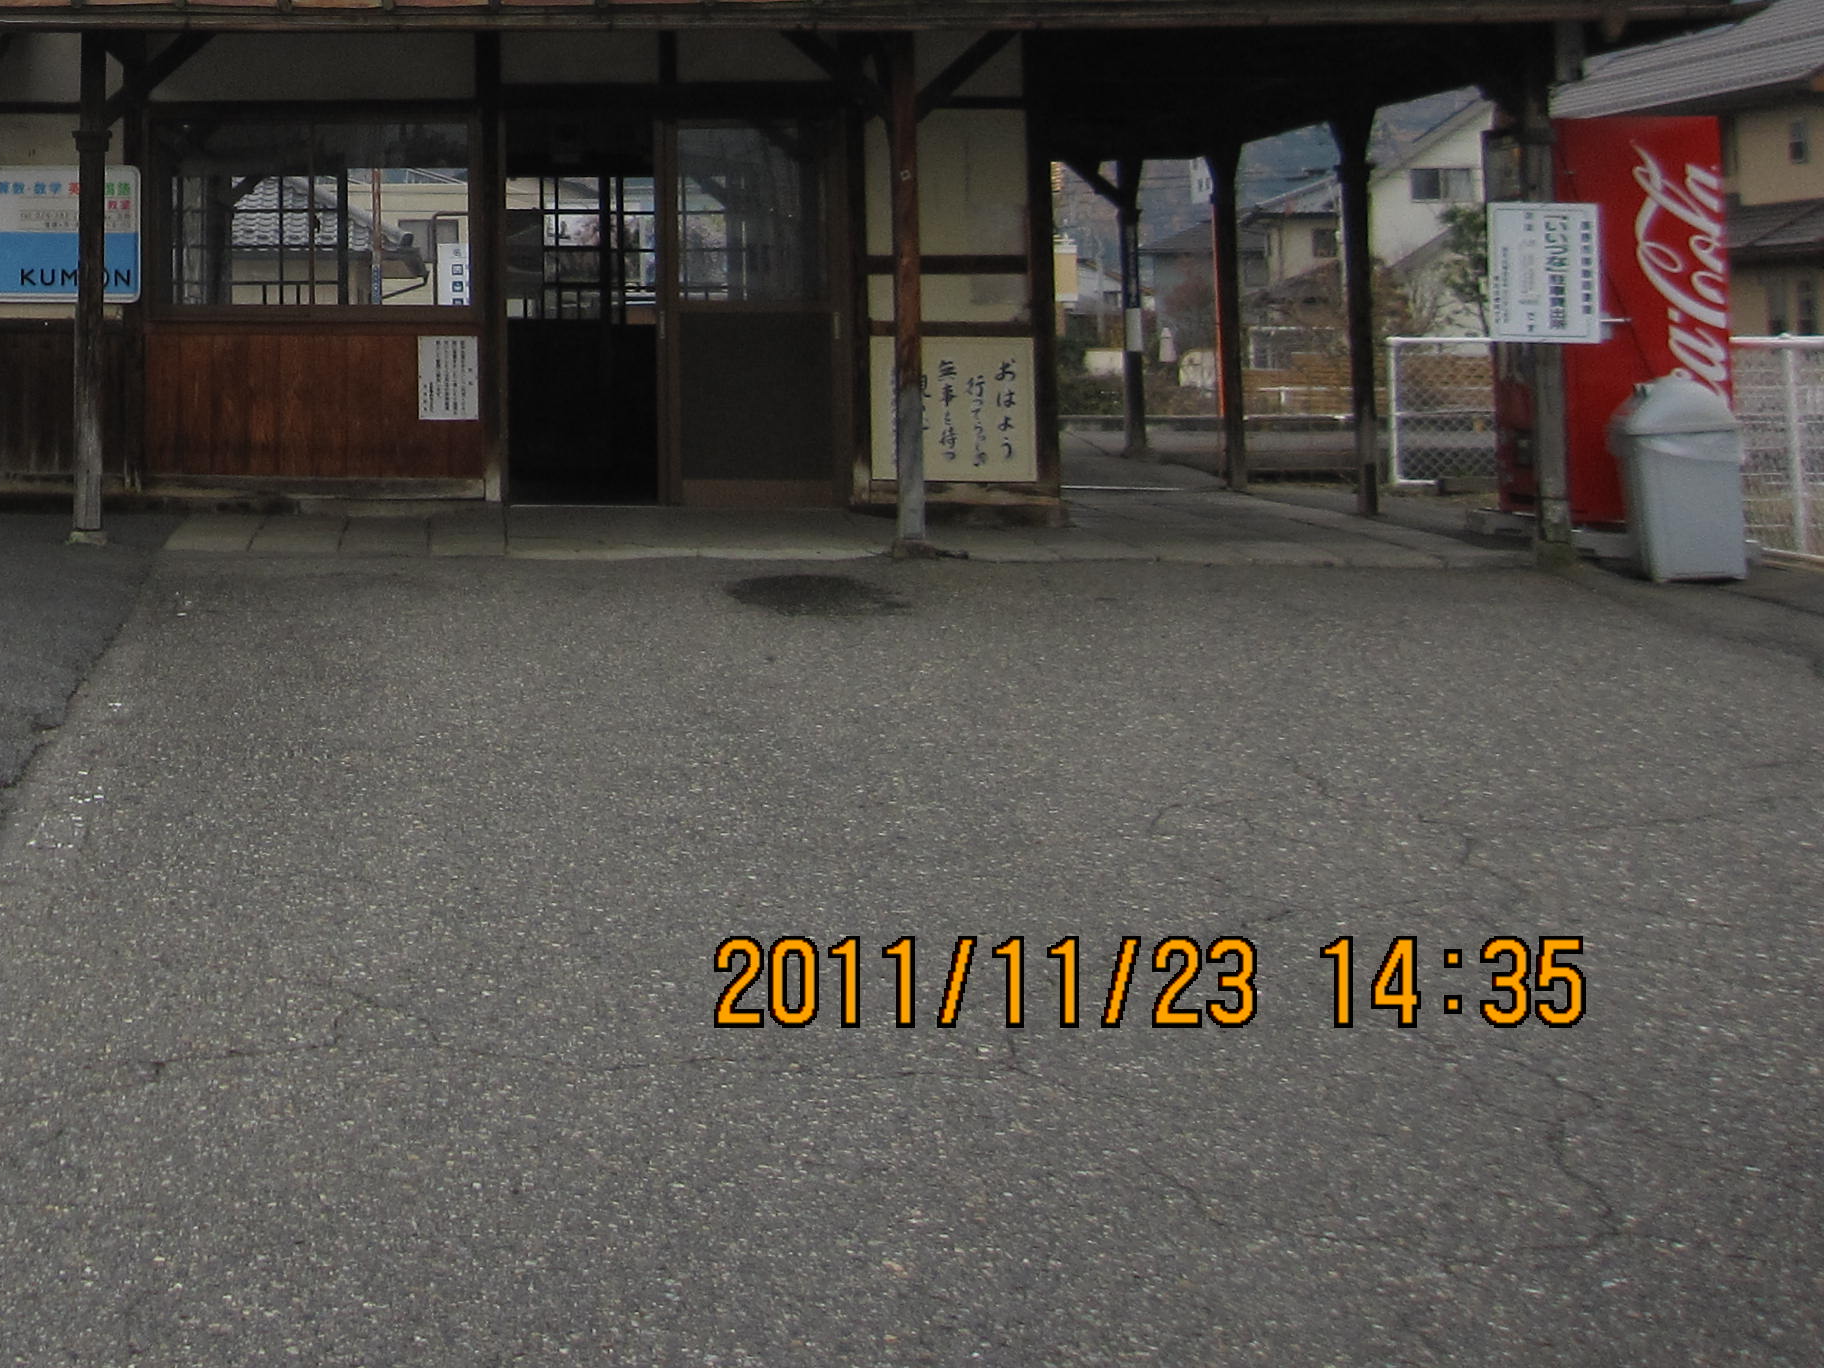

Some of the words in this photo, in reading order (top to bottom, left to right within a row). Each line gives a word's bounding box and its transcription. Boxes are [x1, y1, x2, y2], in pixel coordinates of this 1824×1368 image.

[1629, 138, 1725, 398] a-Cola
[994, 358, 1017, 460] おはよう
